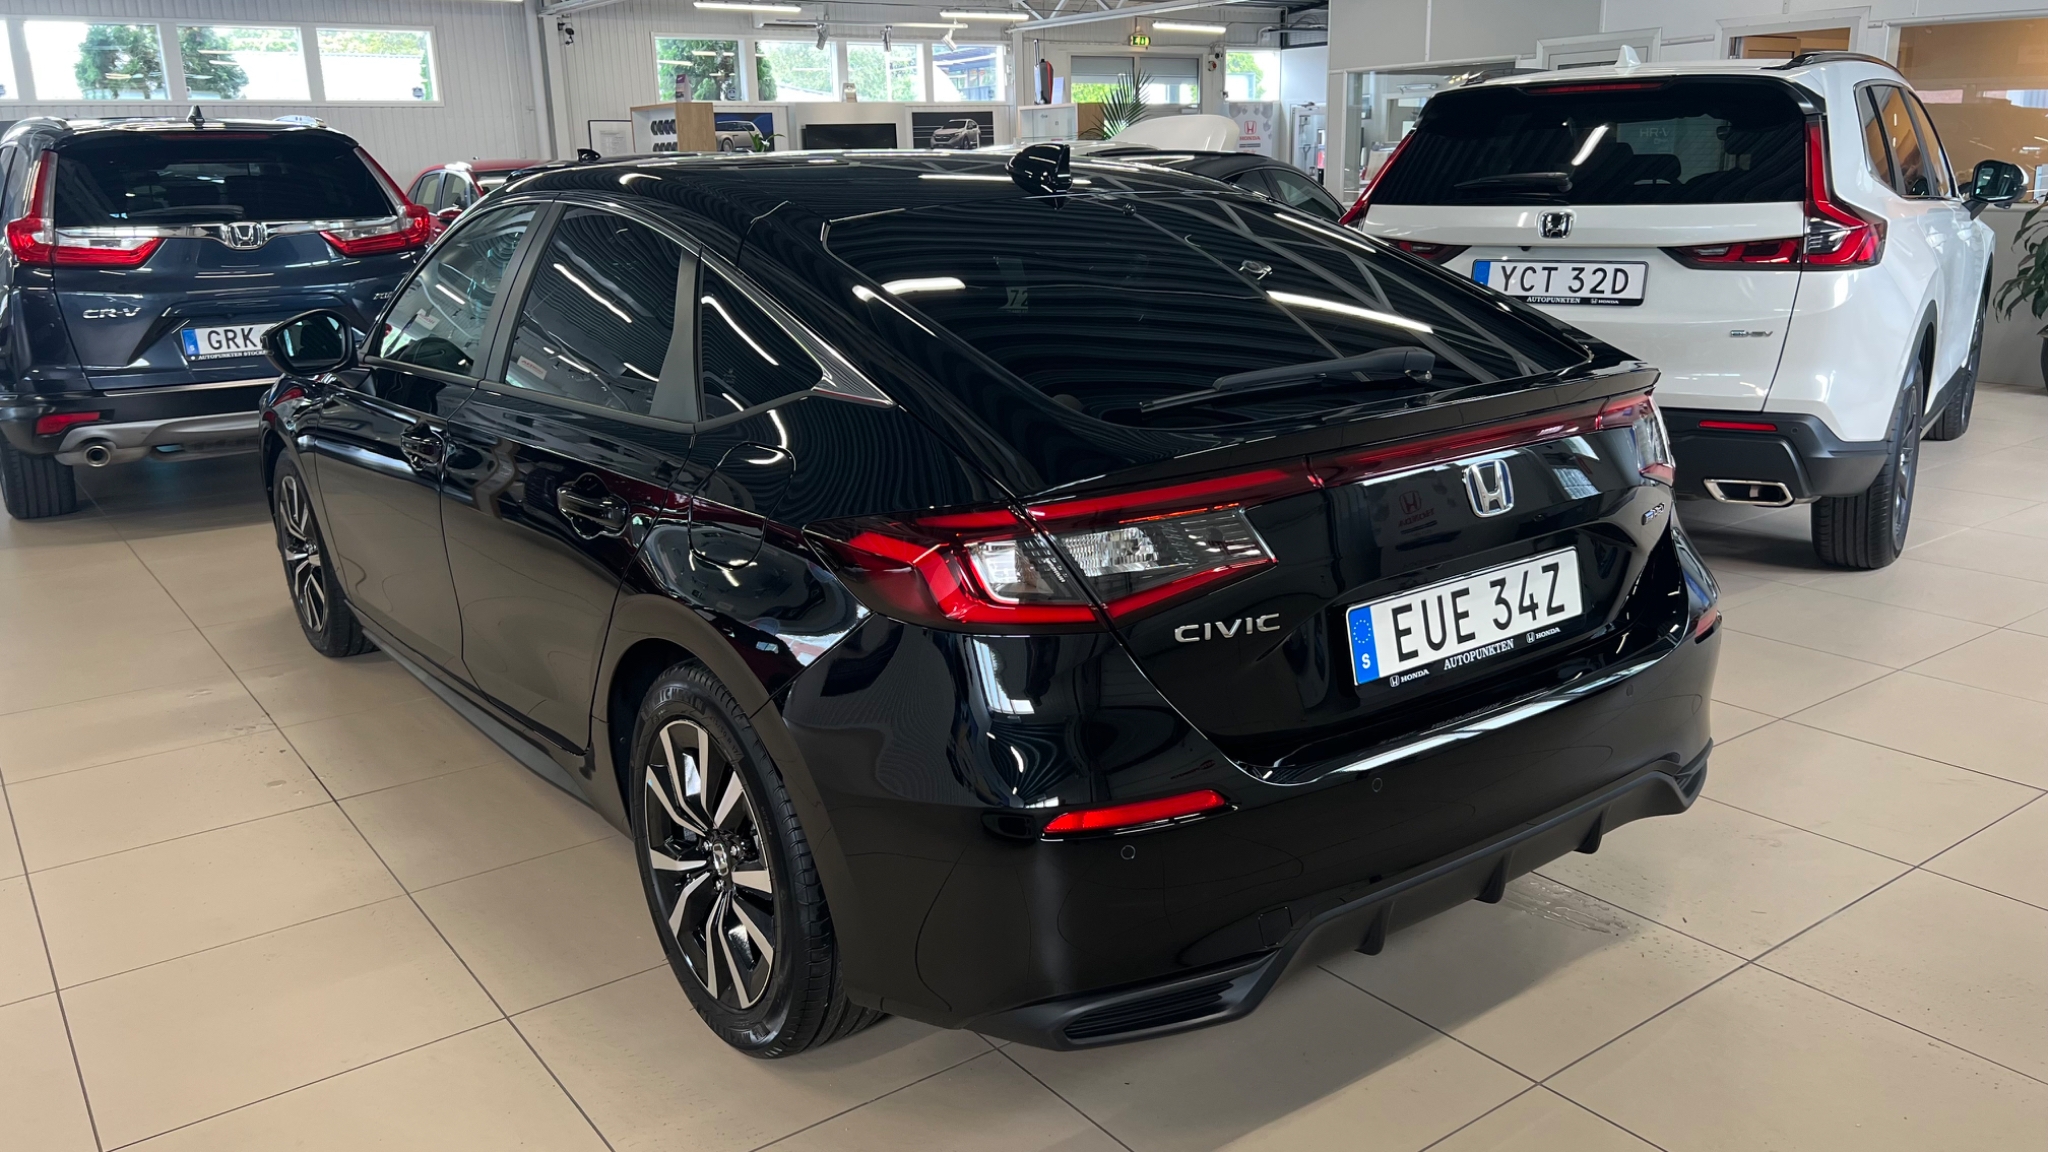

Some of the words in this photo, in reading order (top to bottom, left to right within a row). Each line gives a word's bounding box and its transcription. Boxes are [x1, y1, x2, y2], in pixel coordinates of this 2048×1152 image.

[1500, 265, 1559, 293] YCT
[1567, 266, 1630, 295] 32D
[1526, 296, 1581, 304] AUTOPUNKTEN
[82, 307, 142, 319] CR-V
[207, 327, 257, 351] GRK
[1391, 587, 1476, 663] EUE
[1489, 561, 1566, 631] 34Z
[1174, 613, 1280, 643] CIVIC
[1535, 627, 1561, 639] HONDA
[1361, 653, 1371, 670] S
[1443, 639, 1515, 671] AUTOPUNKTEN
[1400, 669, 1430, 683] HONDA
